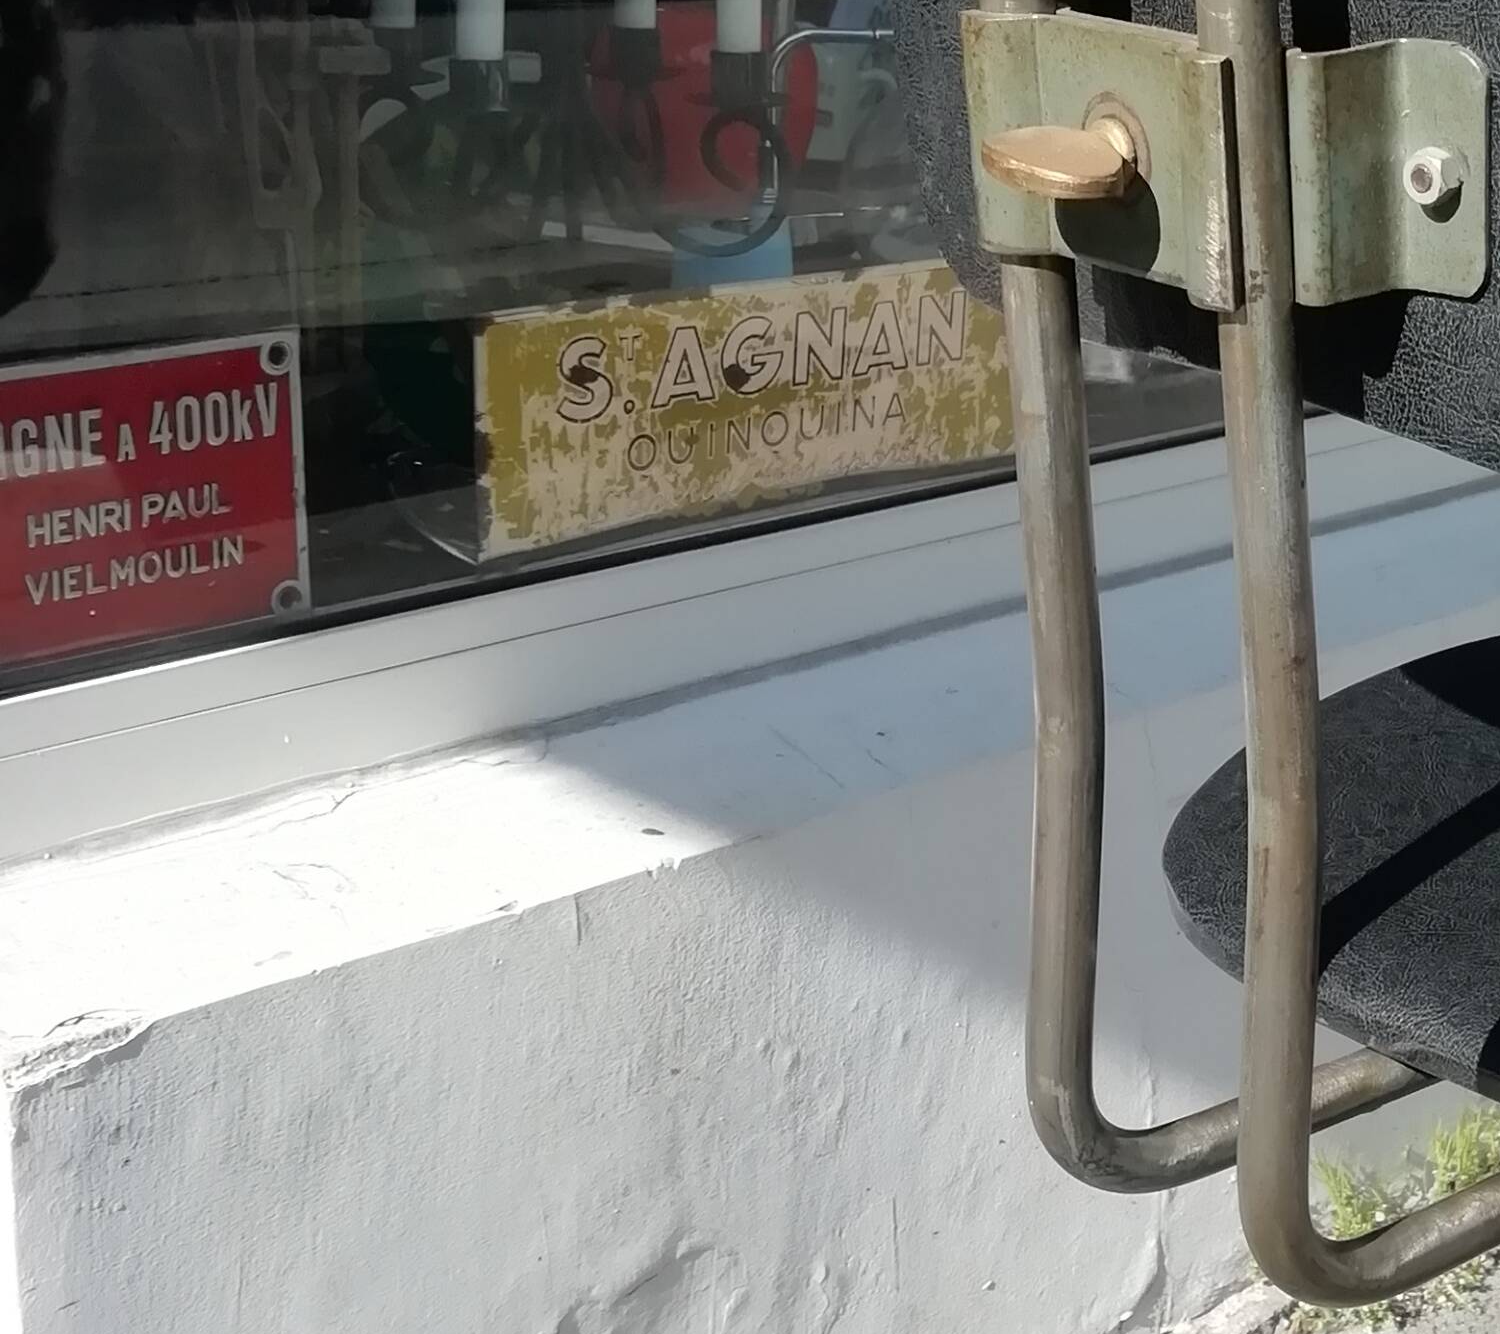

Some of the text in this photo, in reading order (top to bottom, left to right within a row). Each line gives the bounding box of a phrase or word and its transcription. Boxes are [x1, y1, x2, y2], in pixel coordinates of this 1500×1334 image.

[651, 291, 968, 410] AGNAN
[117, 423, 137, 463] A
[149, 381, 279, 455] 400kV
[27, 483, 233, 548] HENRI PAUL
[25, 534, 245, 606] VIELMOULIN
